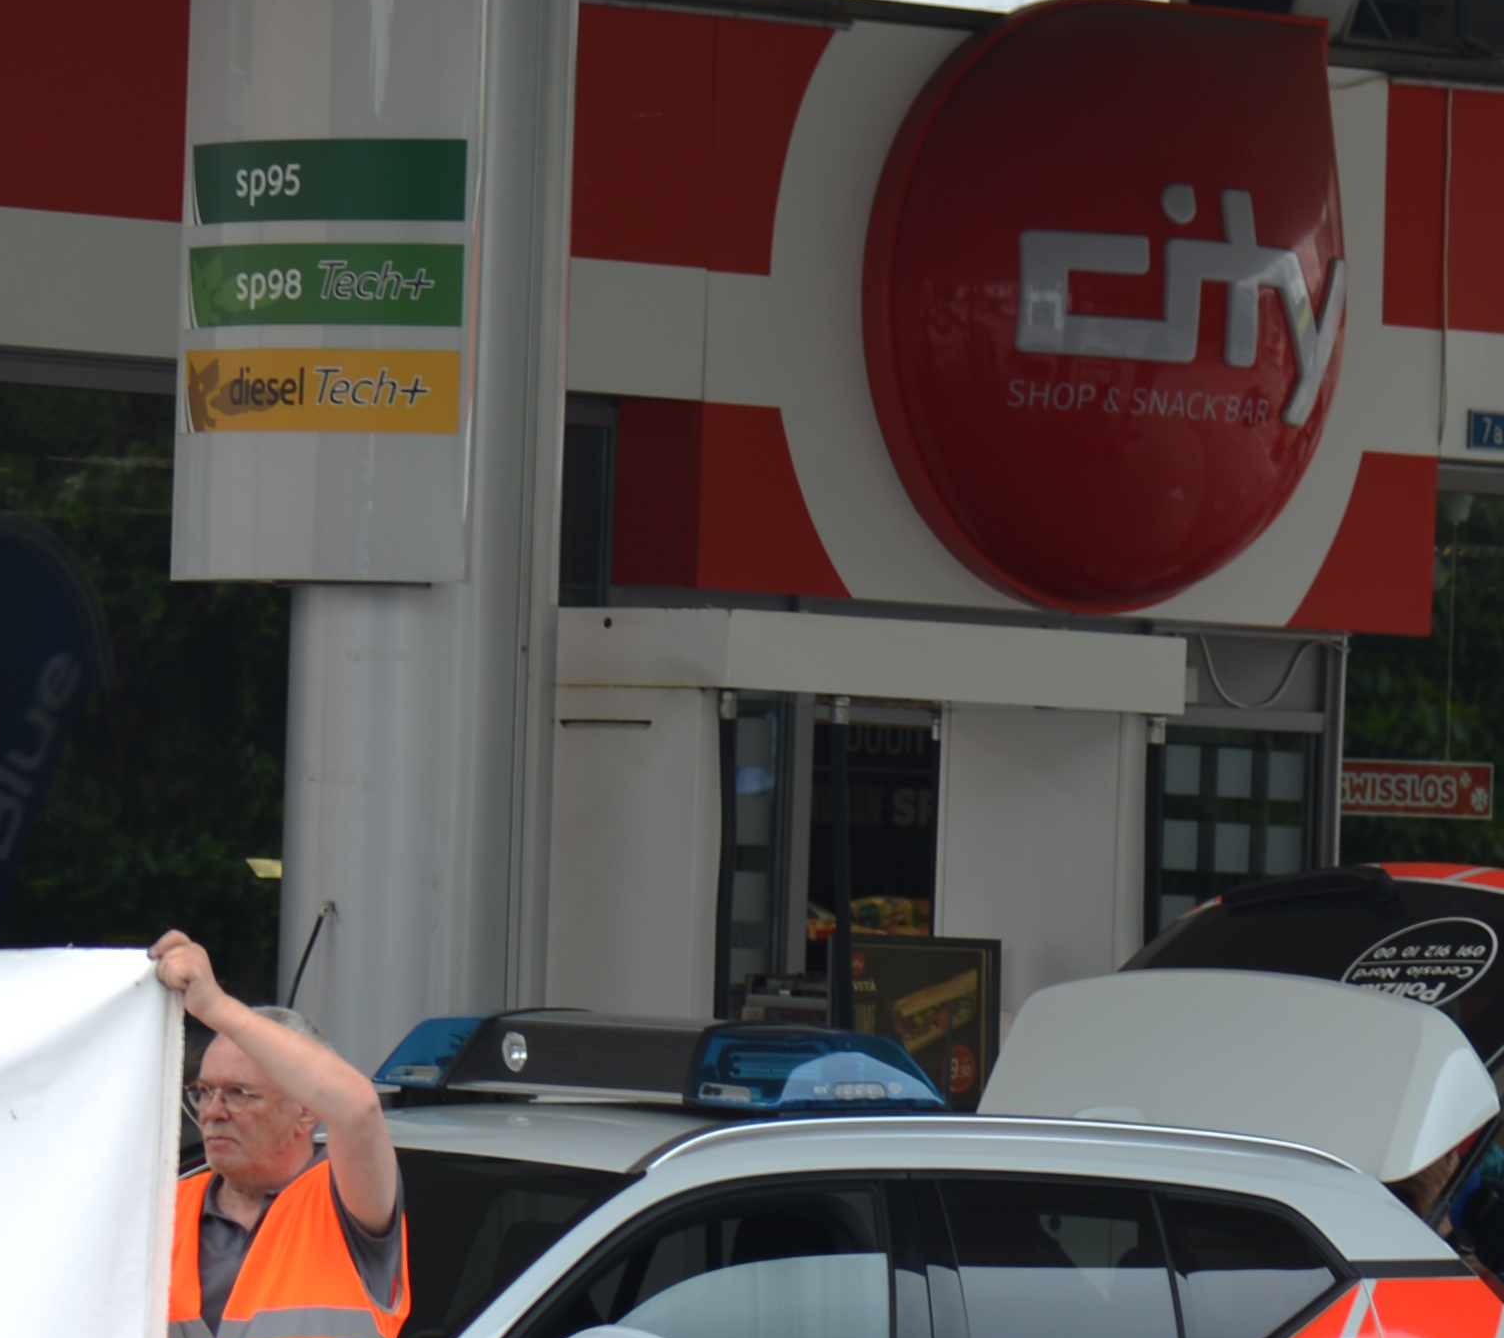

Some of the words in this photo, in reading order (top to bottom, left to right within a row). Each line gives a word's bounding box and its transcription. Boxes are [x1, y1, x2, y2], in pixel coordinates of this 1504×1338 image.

[235, 163, 302, 208] sp95
[235, 267, 303, 310] sp98
[317, 259, 436, 301] Tech+
[1013, 182, 1347, 427] city
[228, 366, 306, 408] diesel
[313, 366, 432, 407] Tech+
[1005, 379, 1097, 412] SHOP
[1101, 387, 1121, 414] &
[1129, 388, 1218, 423] SNACK
[1225, 397, 1271, 427] BAR
[1481, 416, 1504, 446] 7a
